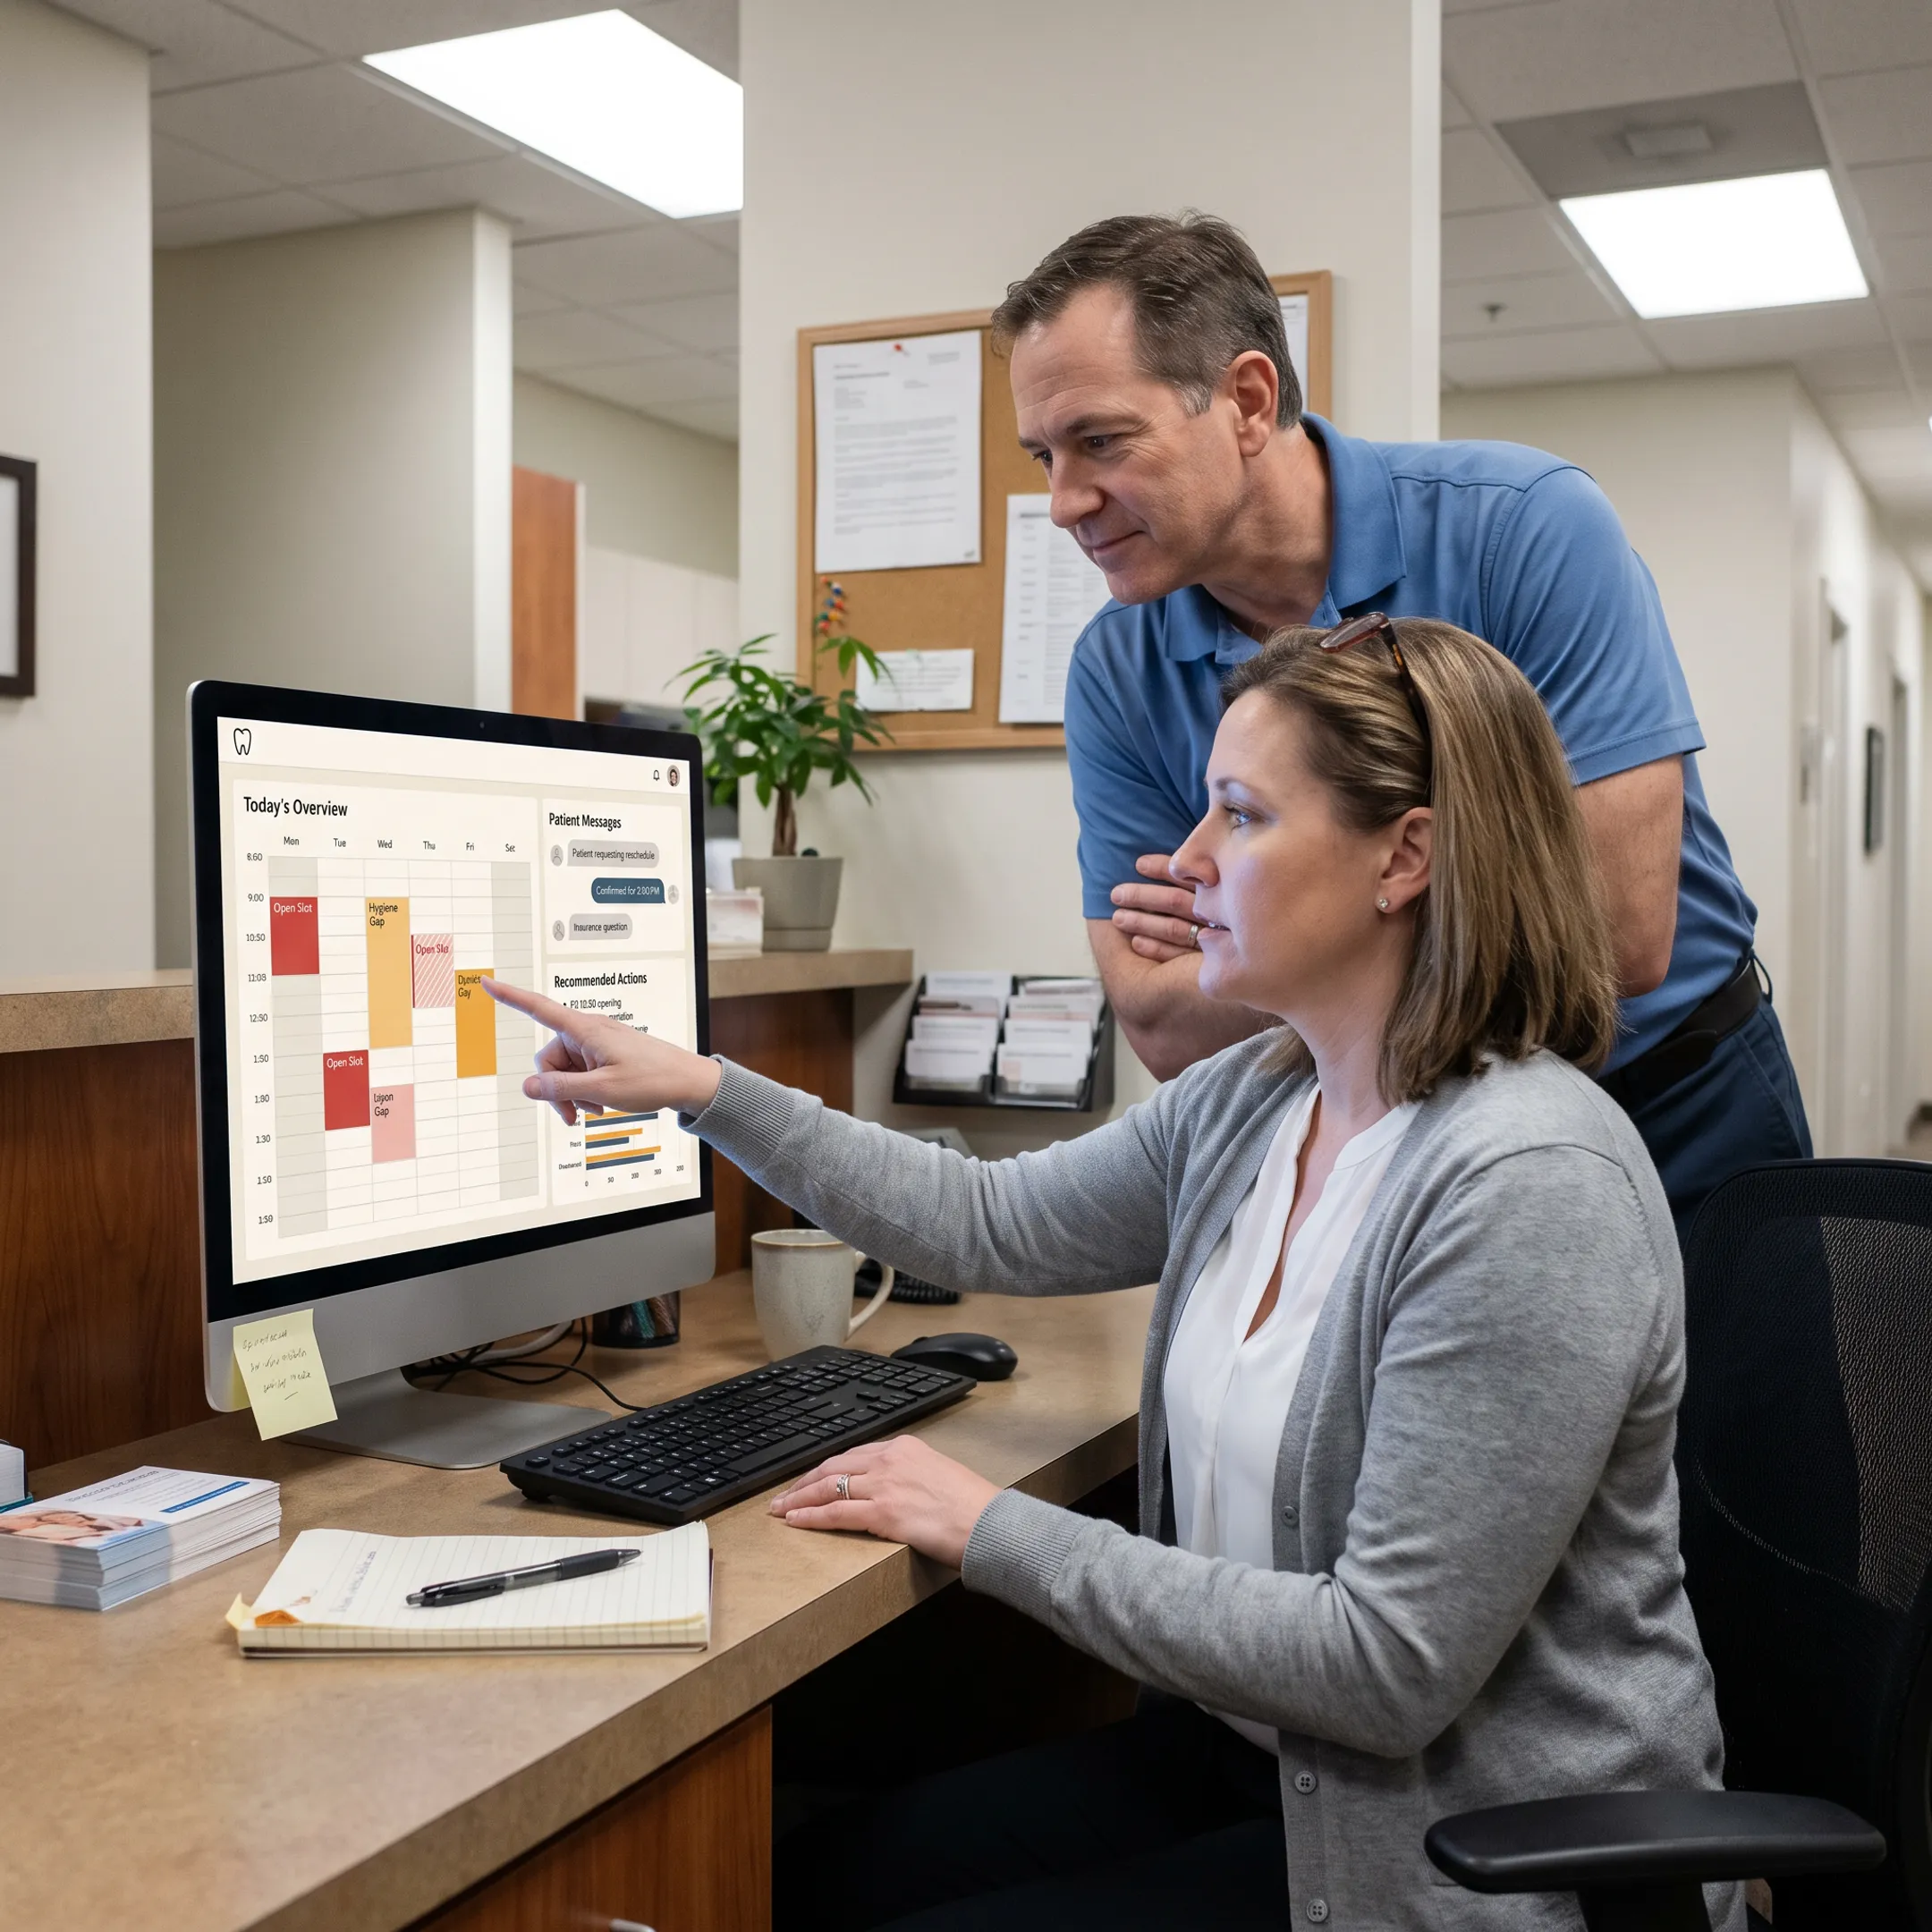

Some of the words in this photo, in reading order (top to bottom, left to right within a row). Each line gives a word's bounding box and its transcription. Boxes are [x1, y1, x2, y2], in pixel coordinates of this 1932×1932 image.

[243, 796, 290, 818] Today's
[293, 799, 348, 816] Overview
[549, 812, 580, 826] Patient
[284, 836, 300, 846] Mon
[333, 838, 346, 848] Tue
[377, 840, 392, 849] Wed
[423, 841, 436, 850] Thu
[466, 843, 475, 851] Fri
[572, 848, 593, 858] Patient
[594, 850, 624, 861] requesting
[596, 886, 626, 894] Confirmed
[627, 886, 636, 894] for
[274, 902, 295, 916] Open
[369, 902, 398, 916] Hygiene
[369, 916, 385, 928] Gap
[415, 944, 436, 956] Open
[555, 973, 615, 988] Recommended
[617, 971, 648, 985] Actions
[326, 1058, 348, 1071] Open
[374, 1106, 390, 1118] Gap
